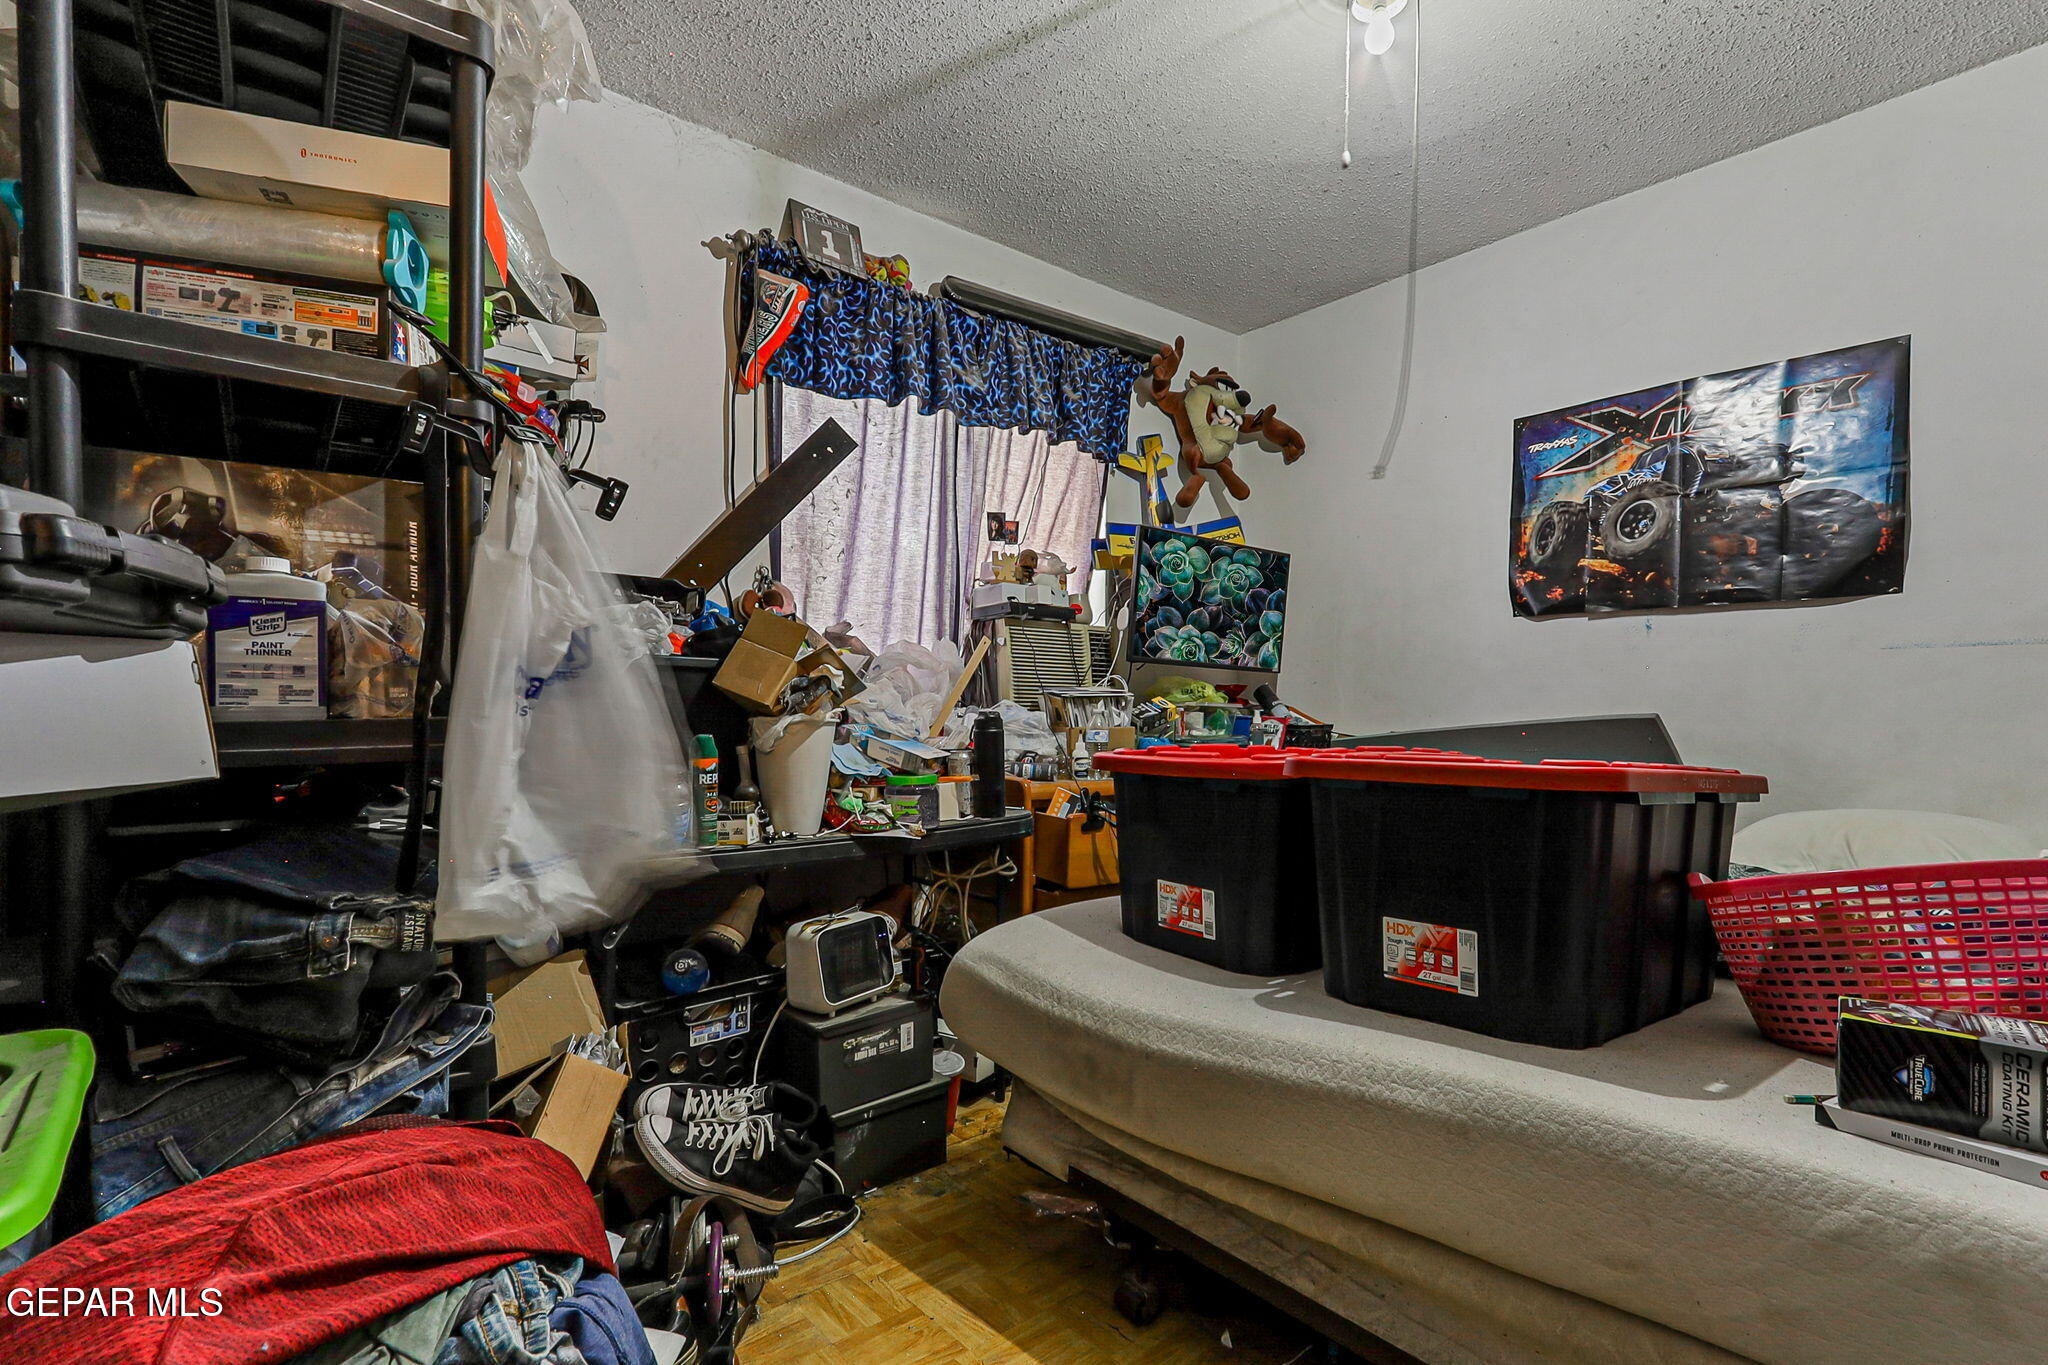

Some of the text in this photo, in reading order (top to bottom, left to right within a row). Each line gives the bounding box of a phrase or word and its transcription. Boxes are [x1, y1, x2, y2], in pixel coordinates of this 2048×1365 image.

[820, 229, 840, 260] 1
[1528, 435, 1578, 454] TRAXXAS
[252, 616, 284, 627] Klean
[255, 623, 280, 632] Strip
[251, 641, 285, 649] PAINT
[243, 648, 292, 656] THINNER
[1160, 883, 1177, 895] HDX
[1386, 920, 1416, 937] HDX
[1387, 936, 1405, 945] Tough
[1422, 971, 1432, 979] 27
[2002, 1052, 2014, 1137] COATING KIT
[2016, 1052, 2032, 1143] CERAMIC
[1890, 1130, 2000, 1167] MULTI-DROP PHONE PROTECTION
